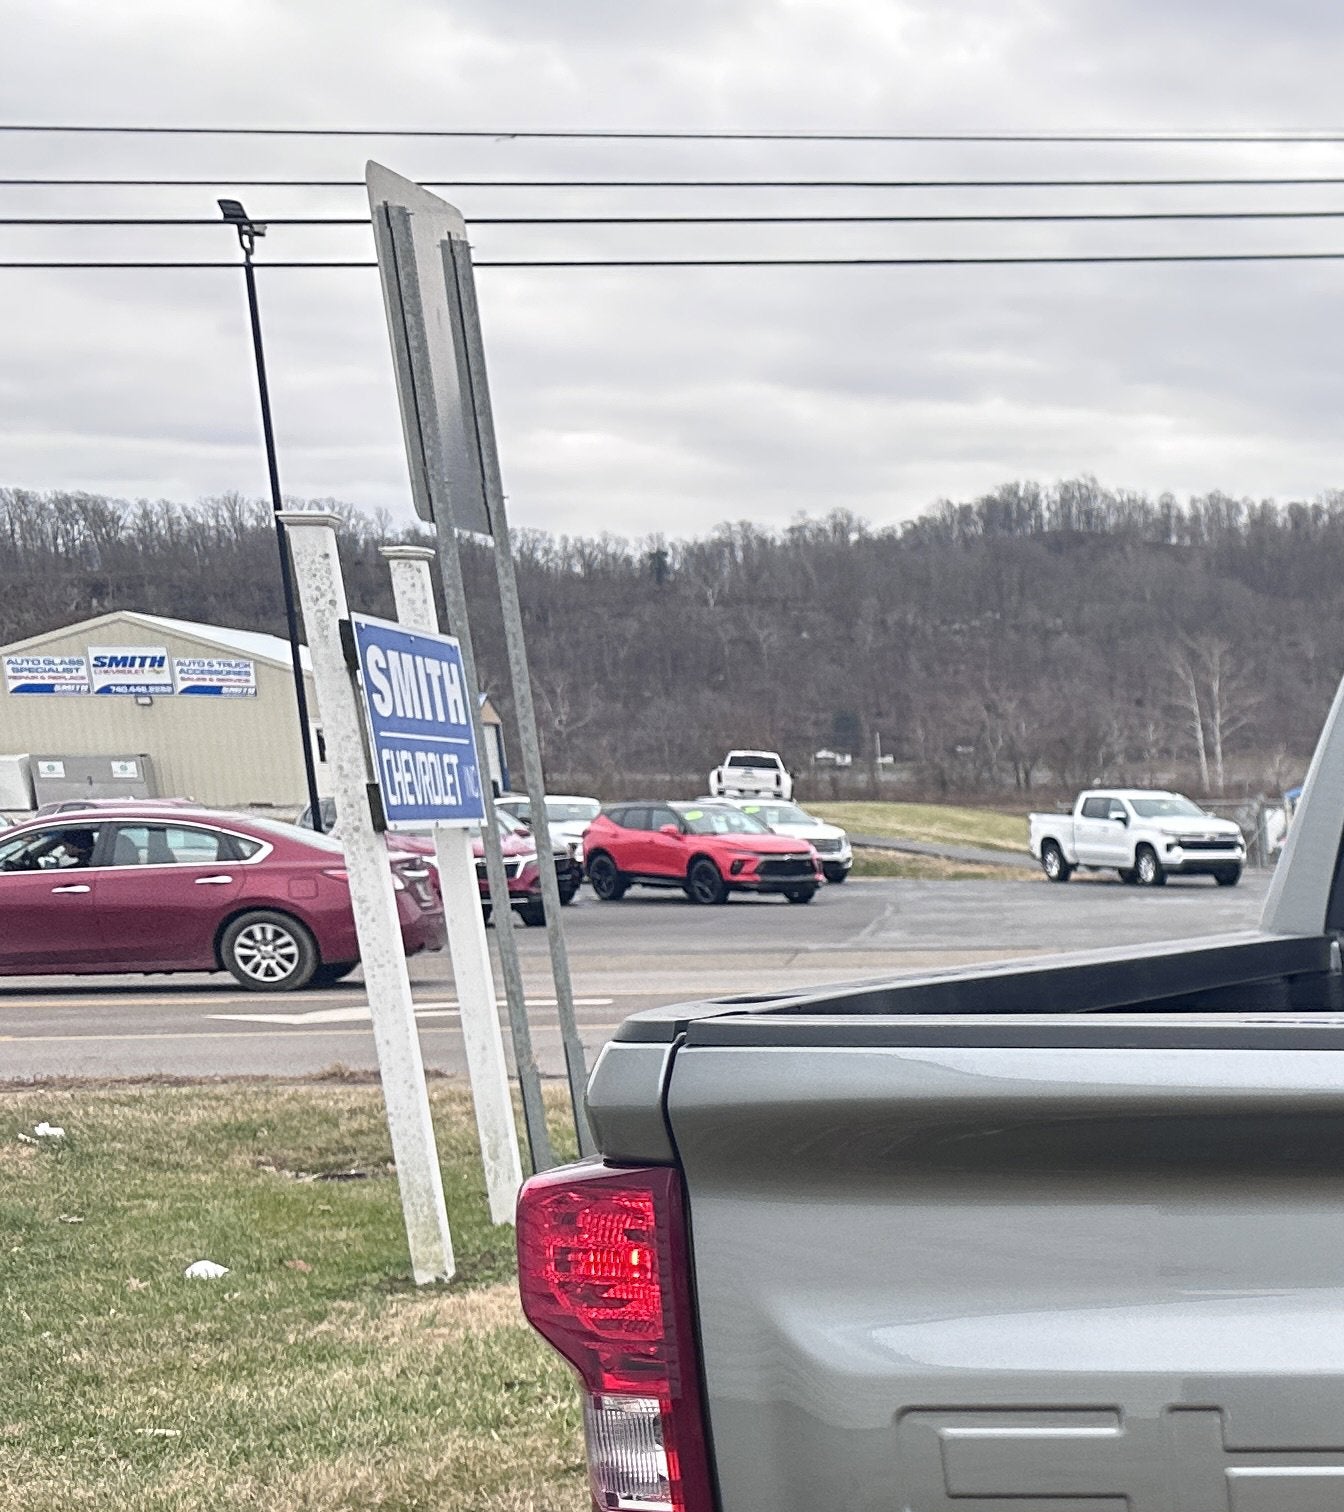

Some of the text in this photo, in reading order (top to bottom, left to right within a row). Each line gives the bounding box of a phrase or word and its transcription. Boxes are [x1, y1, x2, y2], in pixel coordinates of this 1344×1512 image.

[6, 658, 85, 666] AUTO GLASS
[92, 655, 166, 668] SMITH
[176, 659, 206, 668] AUTO
[11, 666, 81, 674] SPECIALIST
[367, 644, 467, 725] SMITH
[381, 748, 463, 806] CHEVROLET
